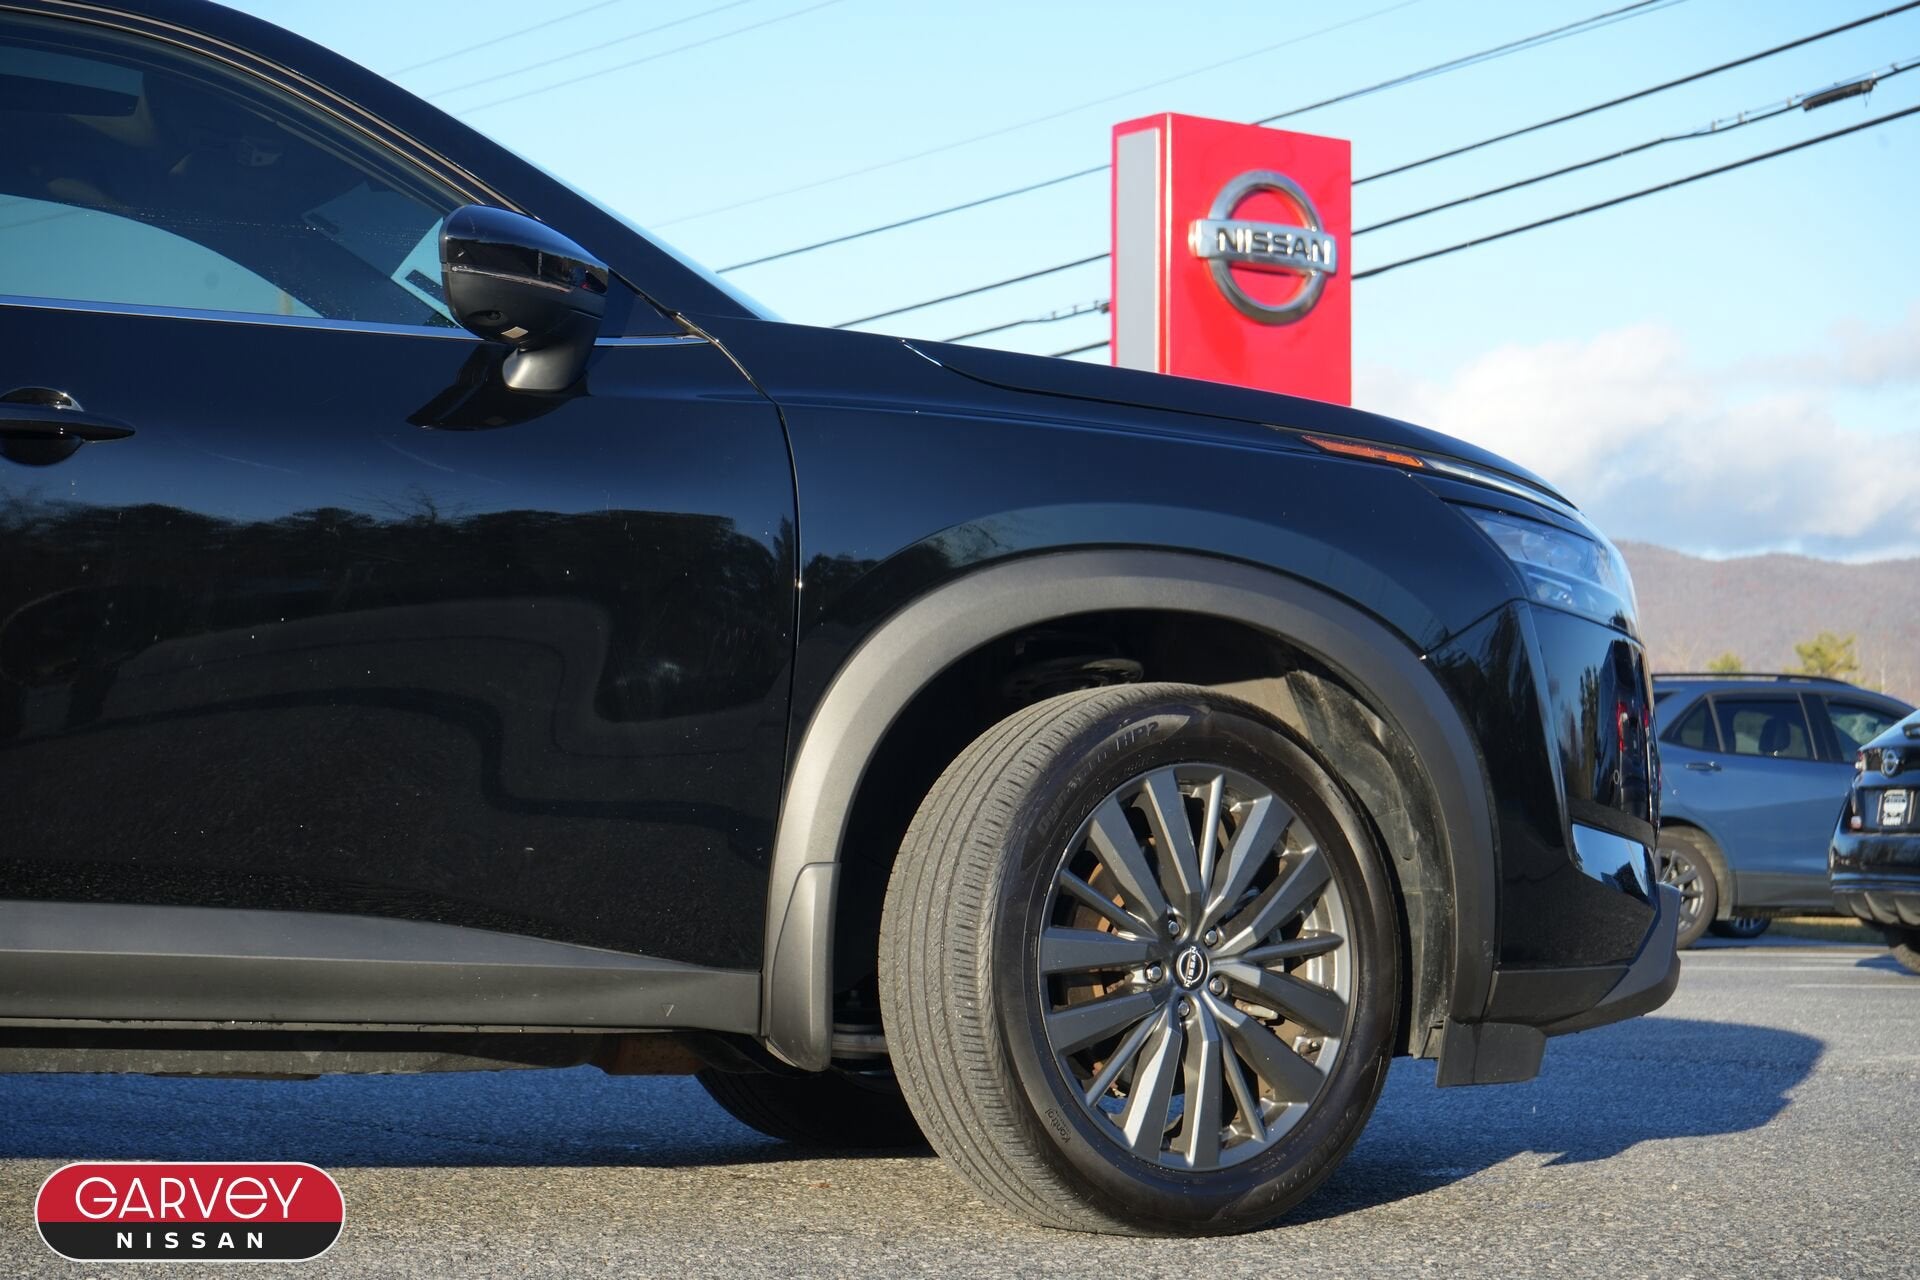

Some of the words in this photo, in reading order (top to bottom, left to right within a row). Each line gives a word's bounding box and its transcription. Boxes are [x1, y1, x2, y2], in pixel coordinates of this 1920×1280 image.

[1216, 227, 1332, 265] NISSAN
[1183, 945, 1197, 988] NISSAN
[1045, 1108, 1071, 1143] Kontrol
